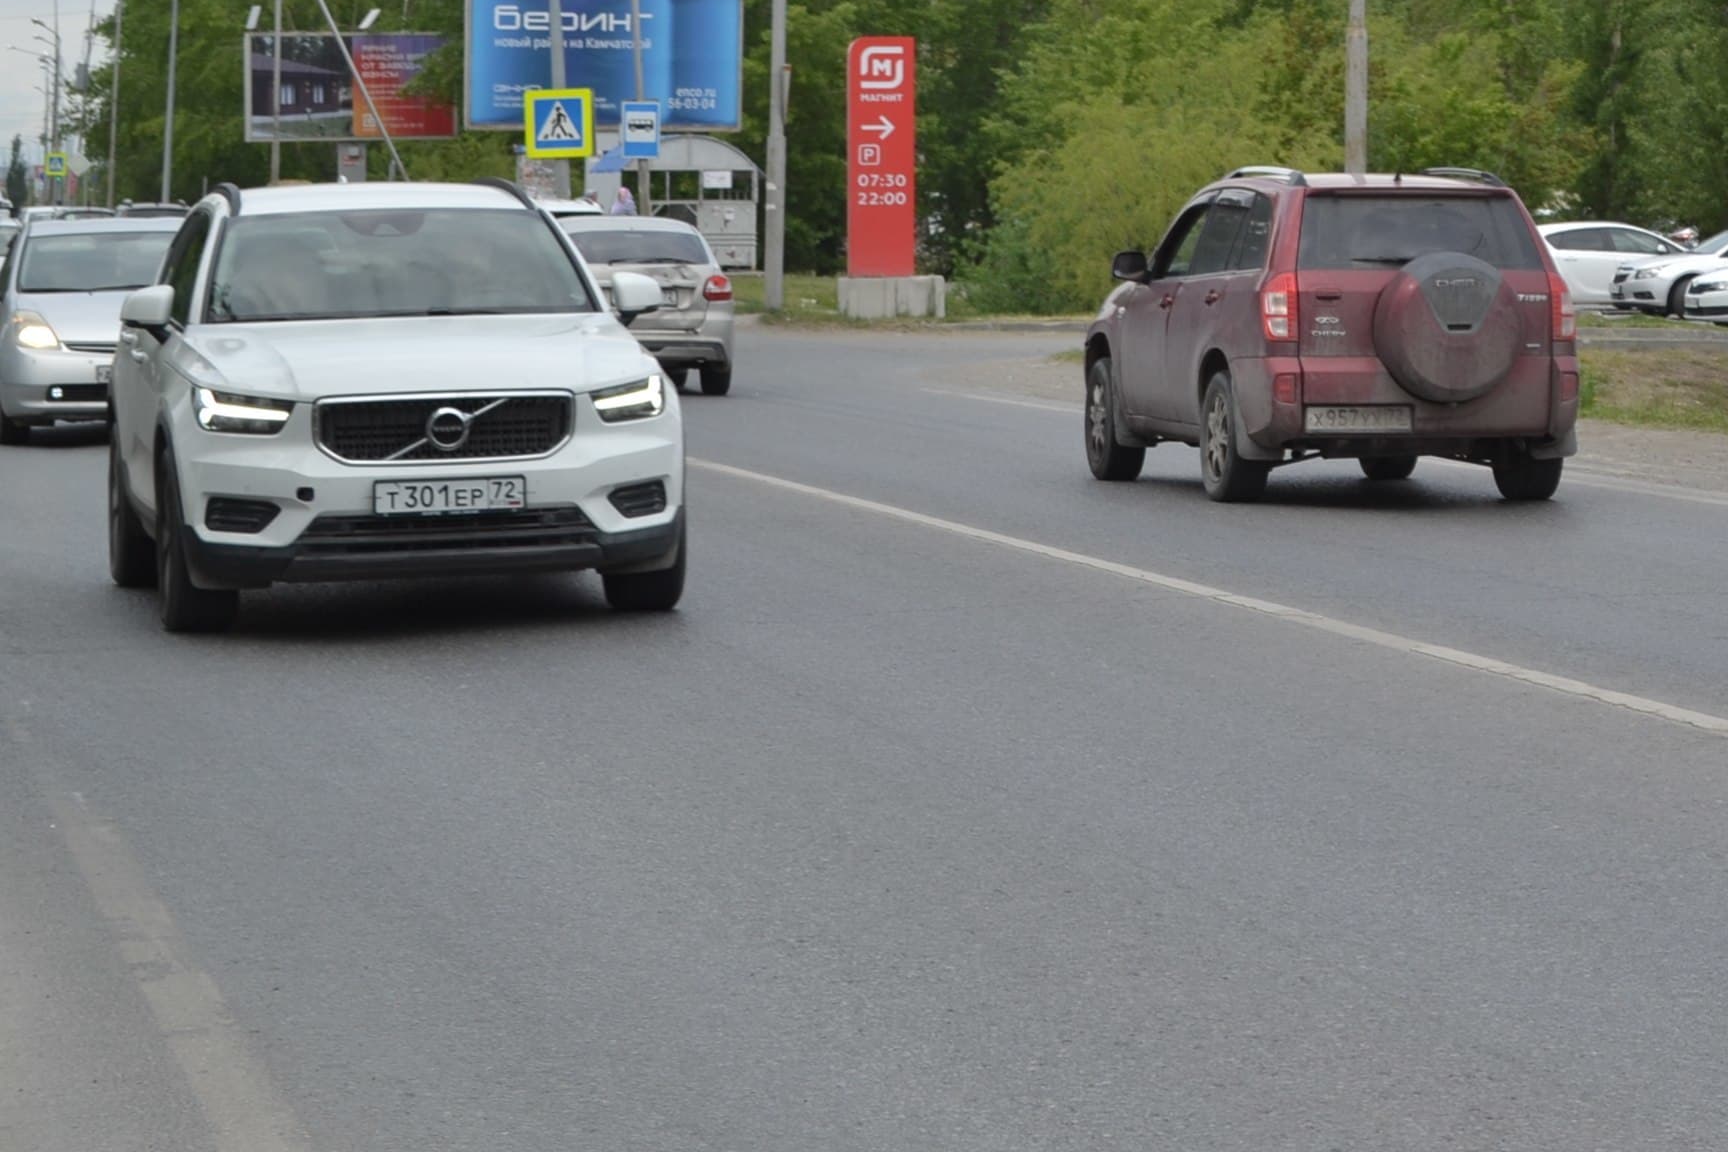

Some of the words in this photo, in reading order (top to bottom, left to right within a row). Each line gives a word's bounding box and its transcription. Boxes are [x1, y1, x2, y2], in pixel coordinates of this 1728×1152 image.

[860, 93, 904, 102] МАГНИТ
[857, 173, 907, 187] 07:30
[857, 191, 907, 205] 22:00
[491, 480, 516, 499] 72
